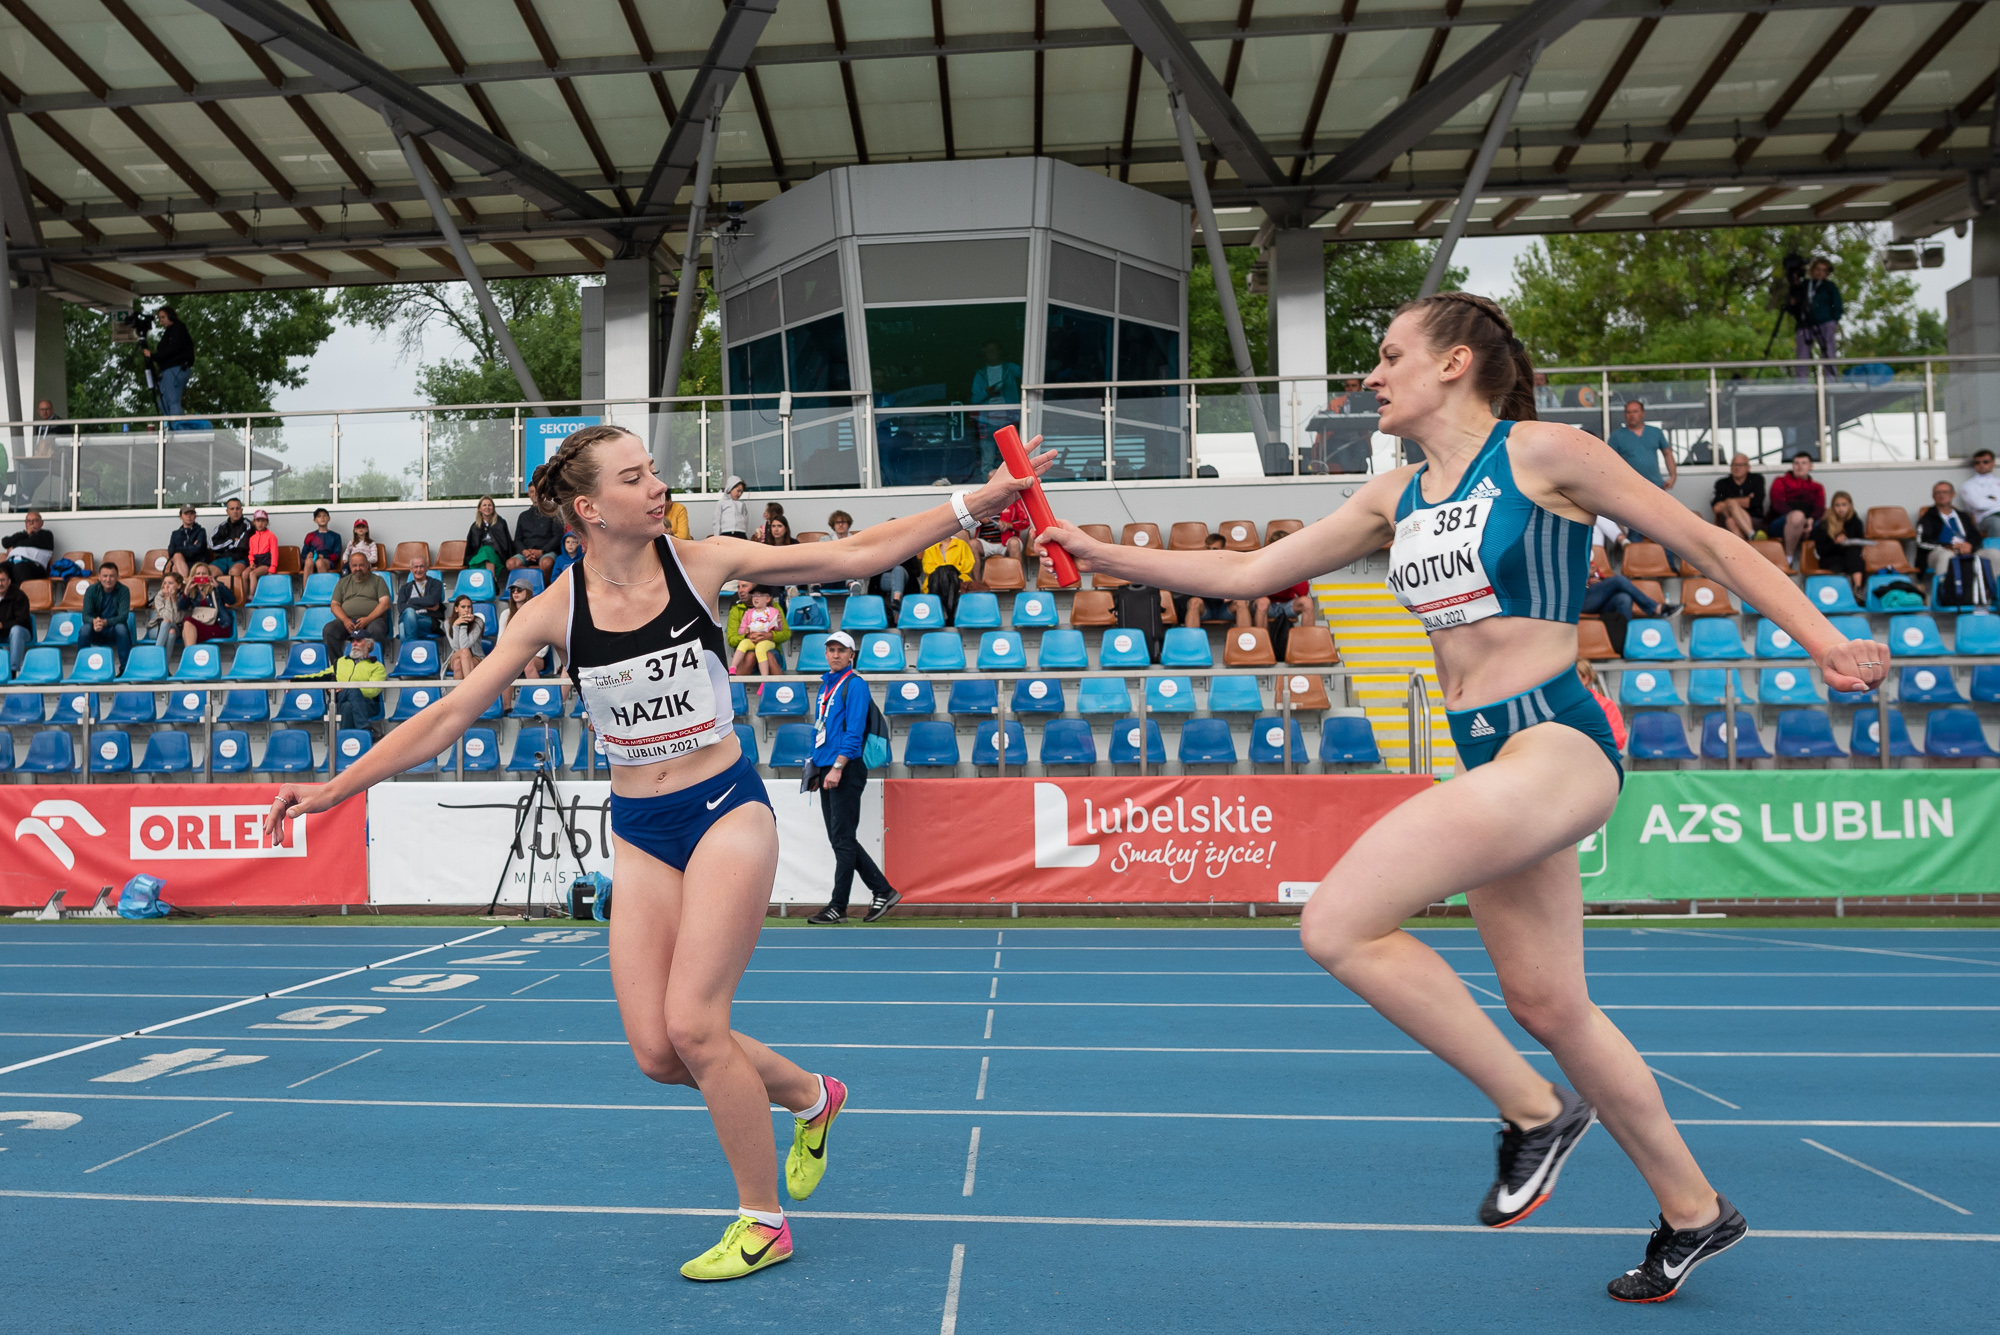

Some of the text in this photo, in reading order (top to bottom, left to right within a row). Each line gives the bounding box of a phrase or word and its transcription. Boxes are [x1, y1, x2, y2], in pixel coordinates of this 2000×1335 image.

[1433, 504, 1478, 536] 381
[1389, 542, 1475, 593] WOJTUŃ
[1444, 609, 1467, 625] 2021
[645, 647, 699, 682] 374
[610, 690, 695, 727] HAZIK
[626, 737, 699, 758] LUBLIN 2021
[1084, 795, 1273, 835] lubelskie
[1639, 803, 1743, 844] AZS
[1760, 797, 1954, 843] LUBLIN
[1110, 839, 1277, 884] Smakuj życie!
